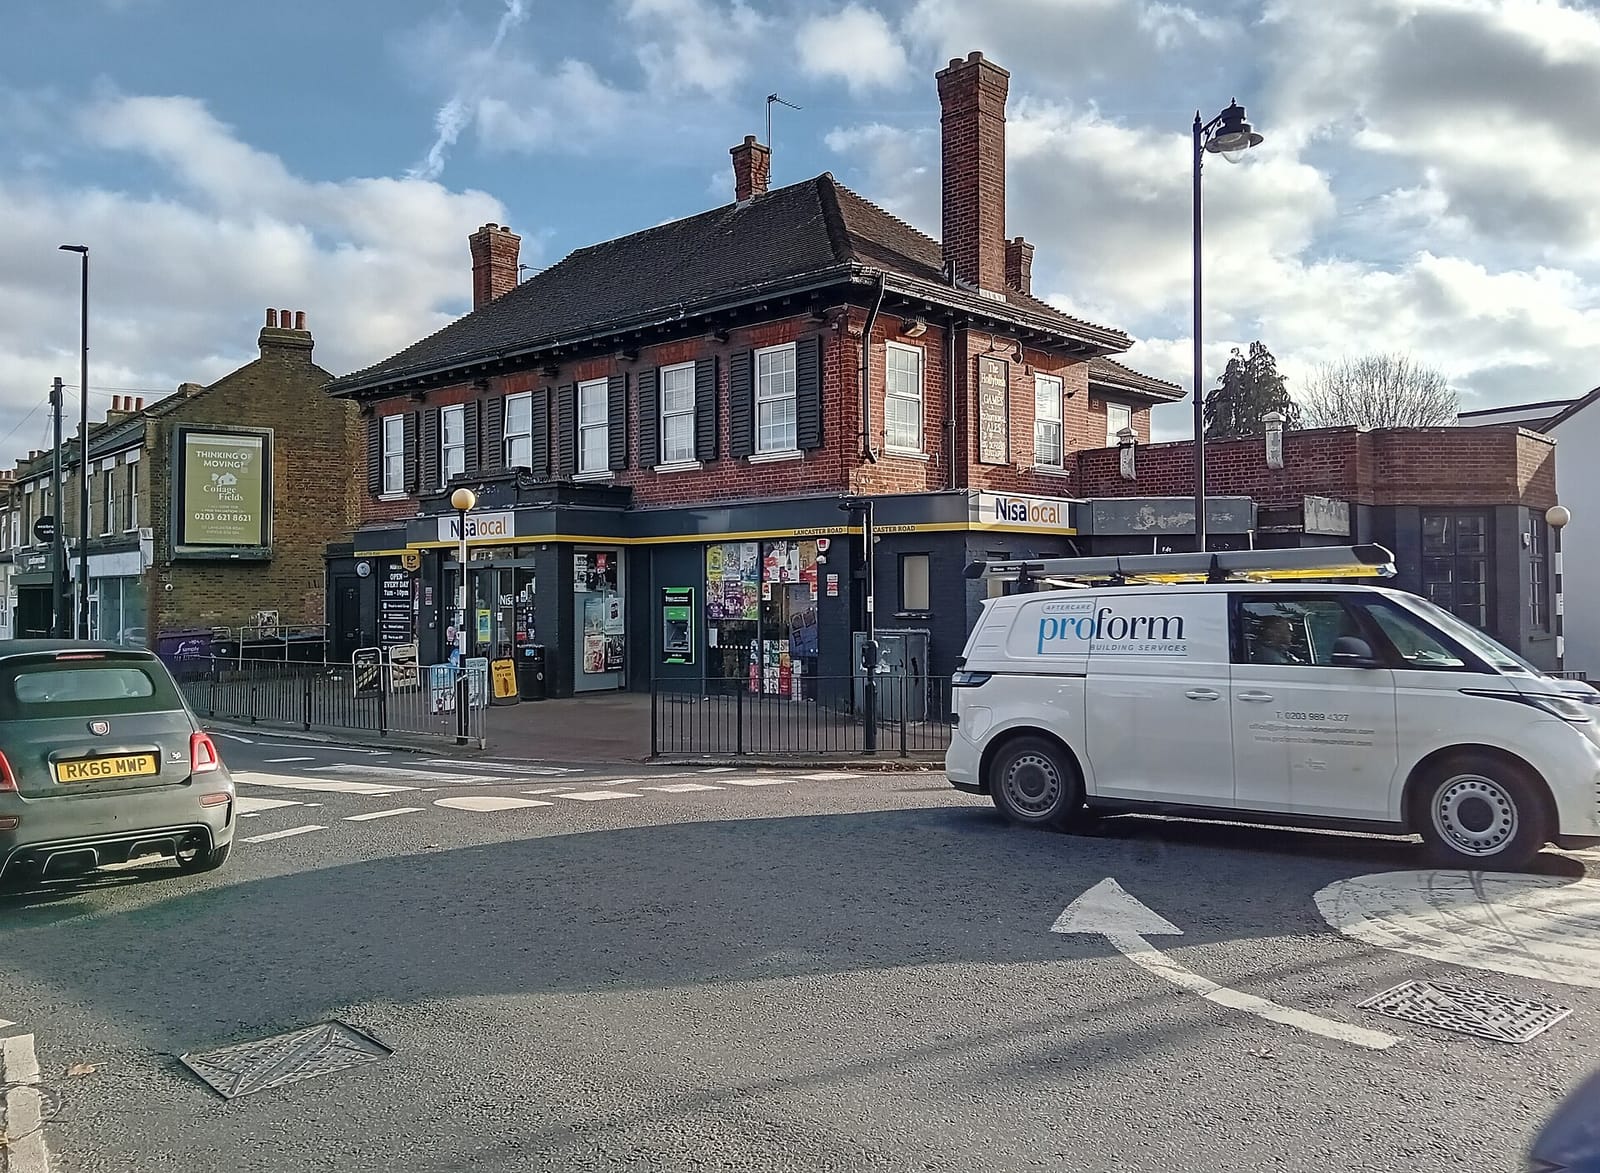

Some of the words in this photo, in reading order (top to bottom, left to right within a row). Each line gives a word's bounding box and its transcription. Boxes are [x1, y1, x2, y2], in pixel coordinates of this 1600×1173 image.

[987, 361, 999, 374] The
[983, 393, 1004, 407] GAMES
[196, 450, 239, 460] THINKING
[203, 460, 244, 468] MOVING?
[218, 493, 244, 501] Fields
[995, 497, 1061, 524] Nisalocal
[194, 512, 215, 521] 0203
[217, 513, 231, 521] 621
[232, 514, 252, 522] 8621
[450, 516, 507, 538] Nsalocal
[793, 528, 826, 536] LANCASTER
[399, 580, 409, 588] DAY
[1037, 607, 1187, 655] proform
[1138, 644, 1187, 652] SERVICES
[1284, 712, 1306, 720] 0203
[1327, 714, 1349, 722] 4327
[66, 761, 112, 779] RK66
[115, 757, 147, 773] MWP
